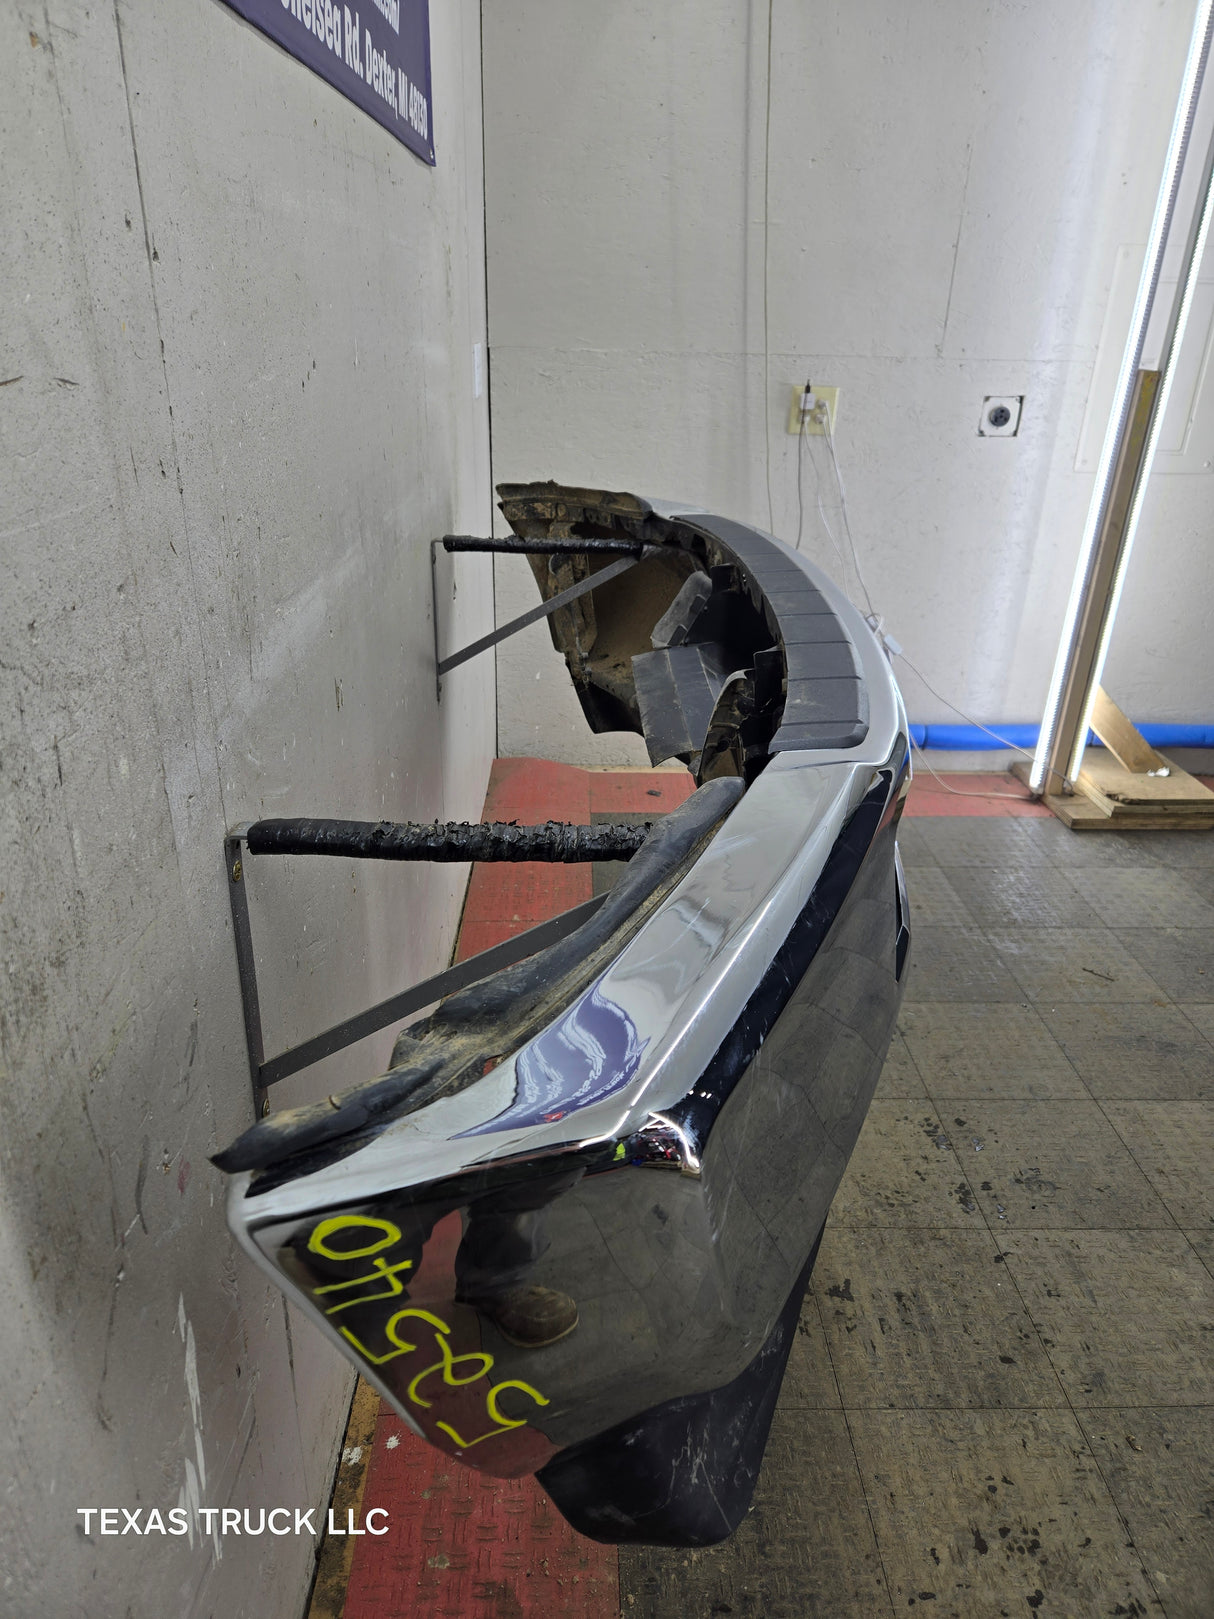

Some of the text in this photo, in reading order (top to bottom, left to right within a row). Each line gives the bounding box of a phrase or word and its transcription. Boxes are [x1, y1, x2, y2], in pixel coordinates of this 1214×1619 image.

[344, 4, 364, 80] Rd.
[366, 28, 398, 121] Dexter,
[398, 67, 409, 121] MI
